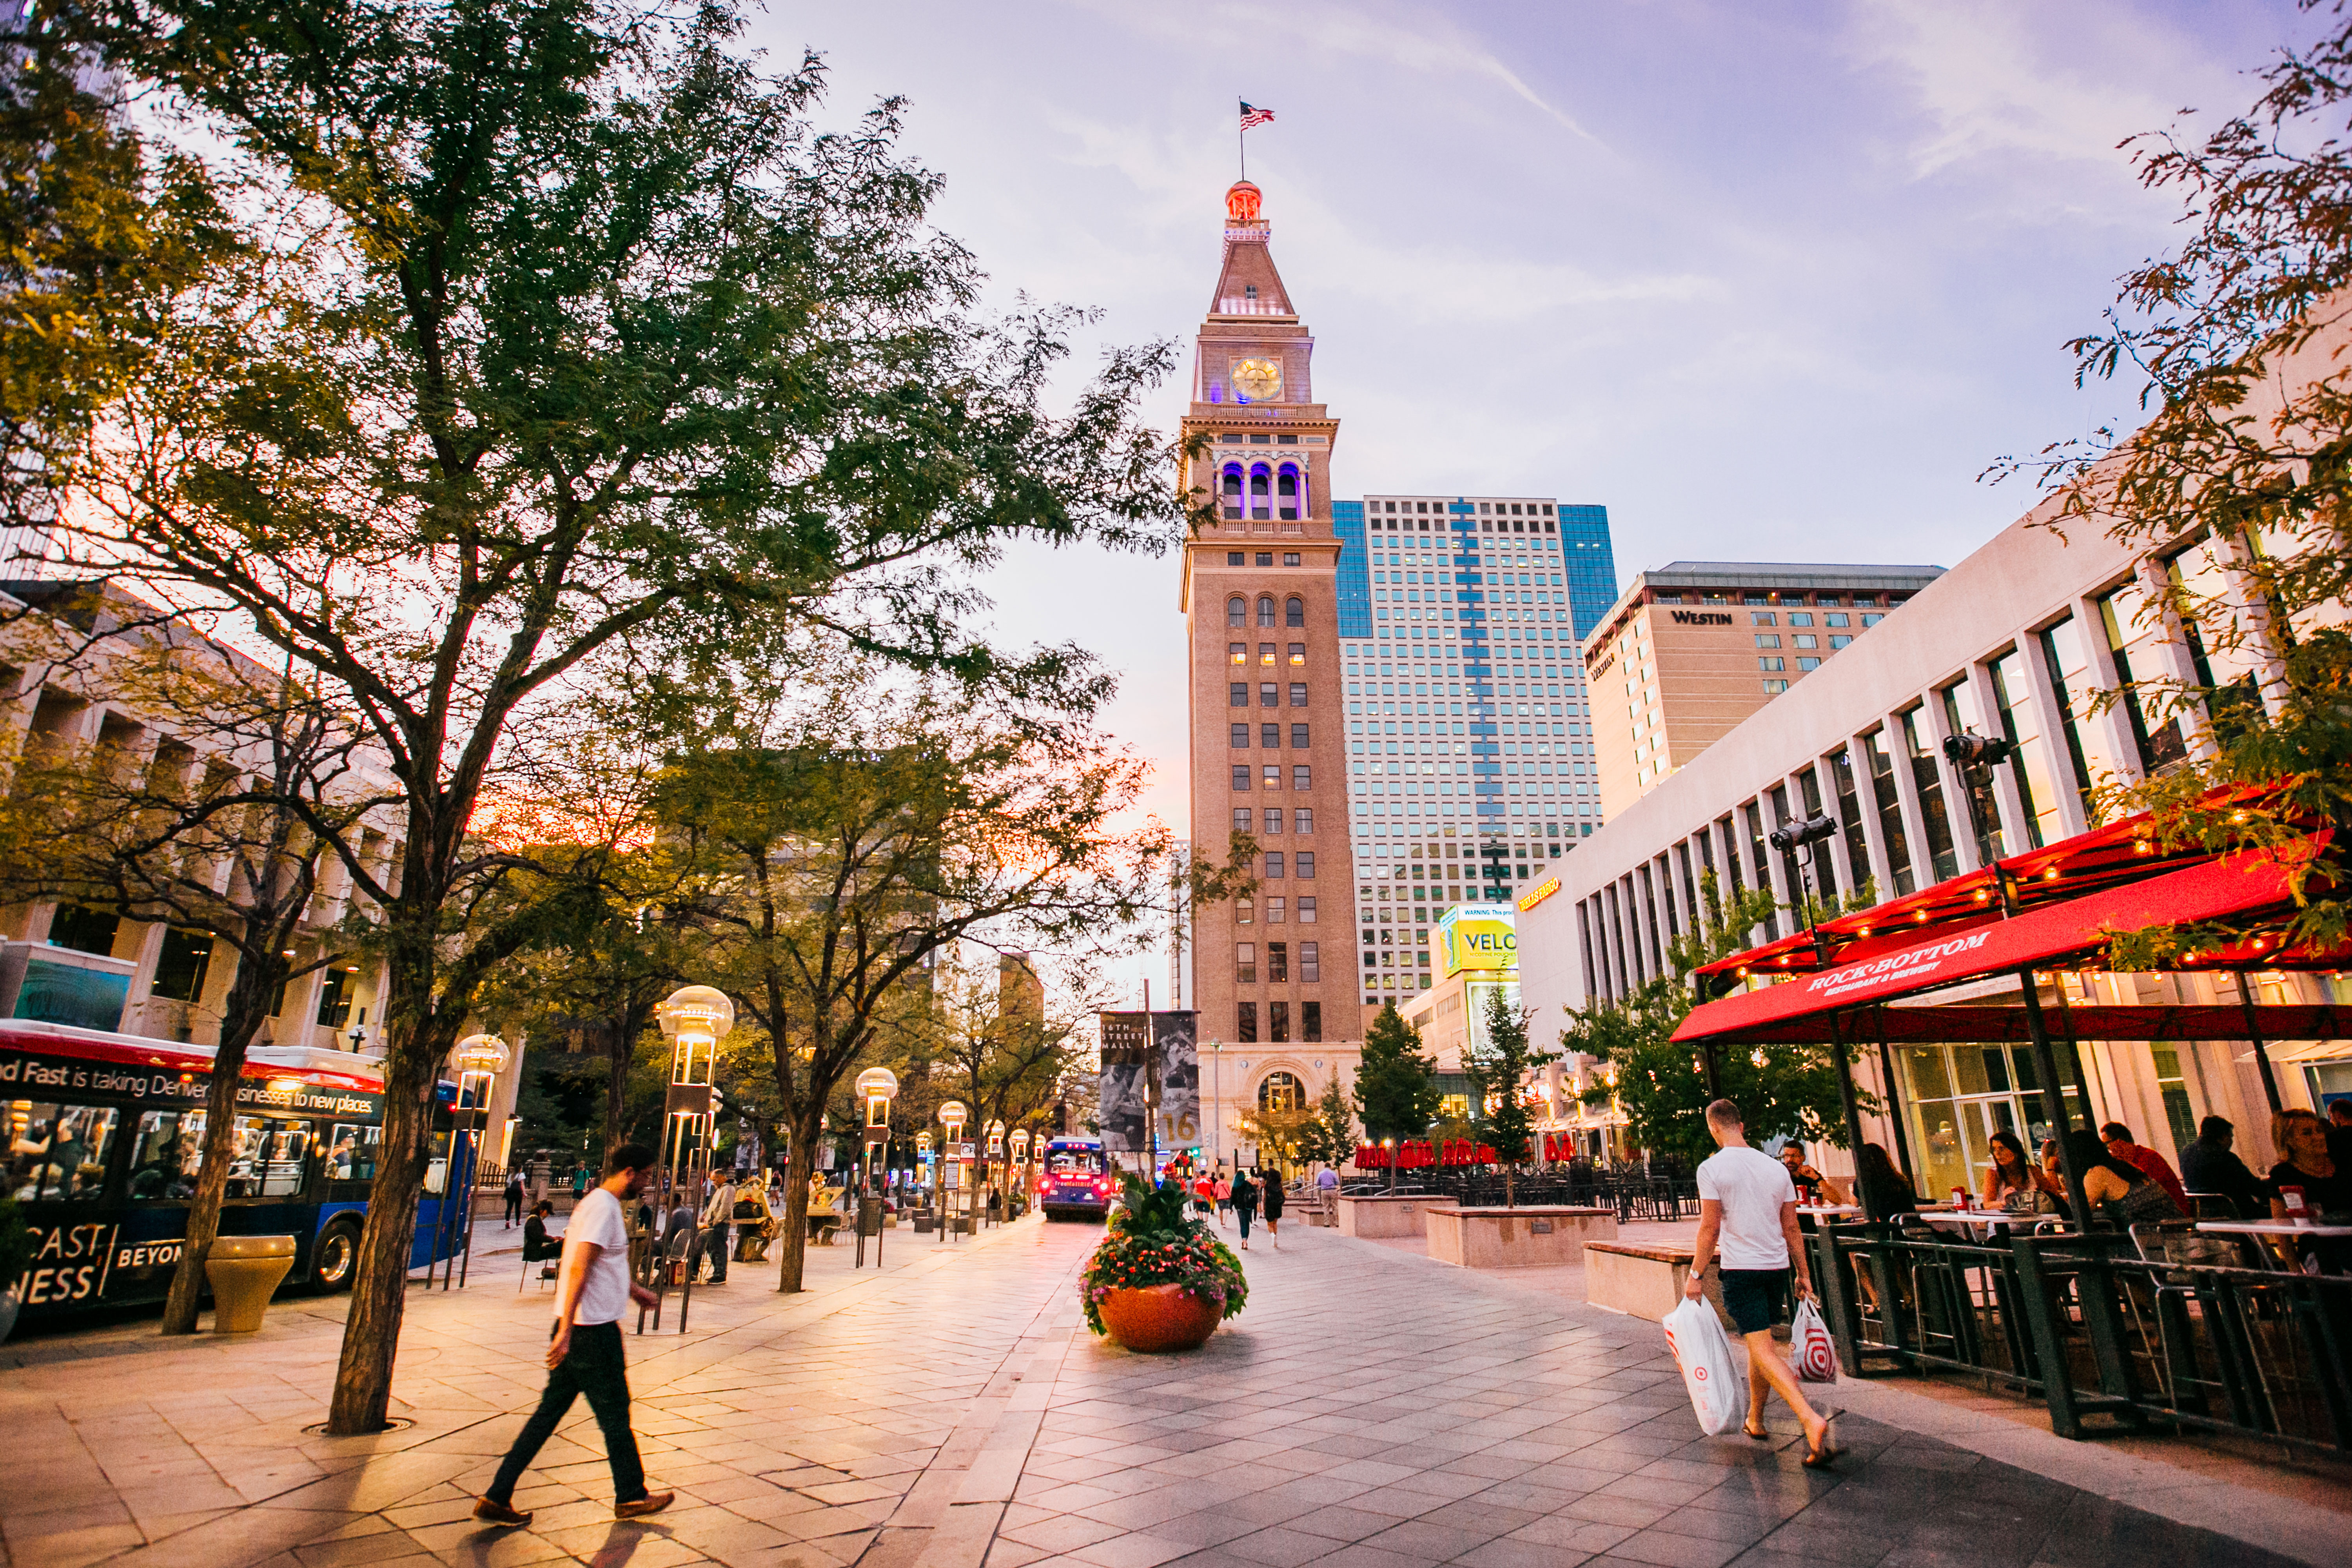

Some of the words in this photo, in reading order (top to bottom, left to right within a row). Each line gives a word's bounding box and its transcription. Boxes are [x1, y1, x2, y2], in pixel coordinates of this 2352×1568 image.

[1671, 610, 1732, 625] WESTIN
[1591, 653, 1614, 682] WESTIN
[1518, 890, 1539, 912] WELLS
[1537, 877, 1559, 900] FARGO
[1465, 933, 1516, 950] VELO
[1824, 975, 1882, 996] RESTAURANT
[1880, 974, 1890, 982] &
[1890, 961, 1941, 980] BREWERY
[22, 1061, 71, 1086] Fast
[72, 1066, 88, 1087] is
[91, 1069, 148, 1098] taking
[294, 1091, 307, 1107] to
[308, 1094, 337, 1110] new
[335, 1094, 373, 1114] places.
[1163, 1112, 1196, 1142] 16
